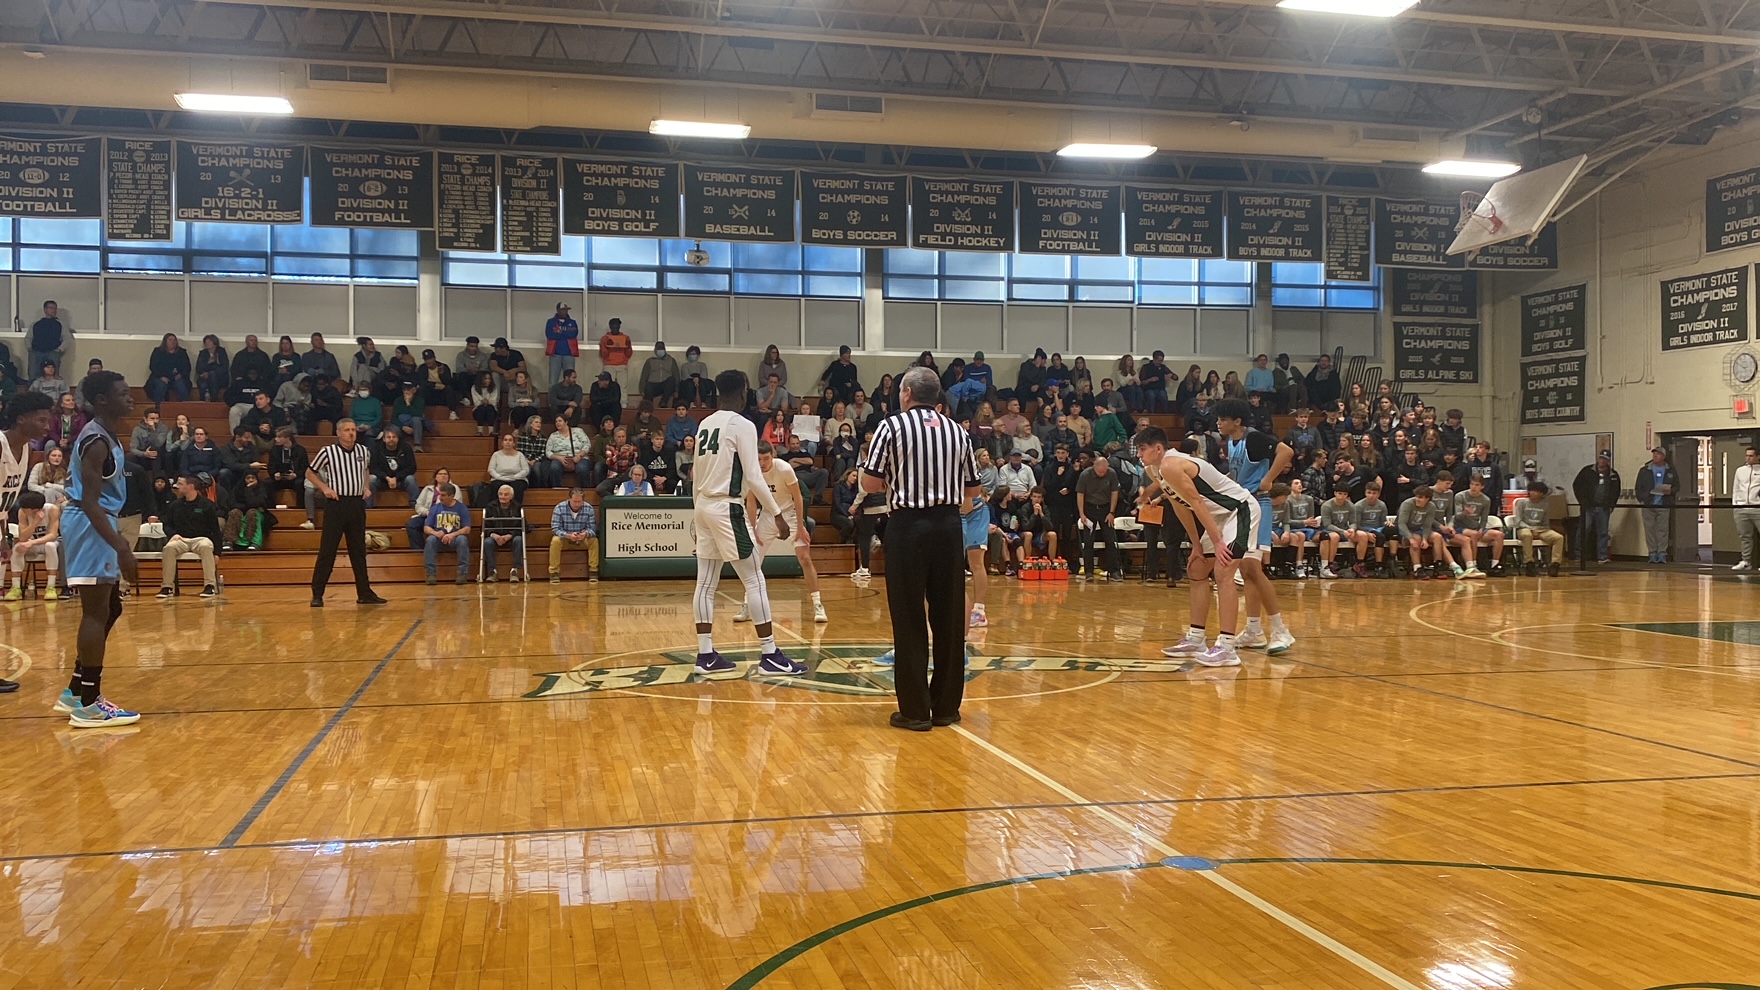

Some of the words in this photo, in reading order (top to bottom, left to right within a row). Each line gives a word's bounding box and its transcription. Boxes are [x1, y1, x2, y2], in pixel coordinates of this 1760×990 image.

[47, 143, 85, 152] STATE
[125, 142, 153, 150] RICE
[191, 145, 248, 155] VERMONT
[254, 148, 292, 158] STATE
[0, 154, 79, 166] HAMPIONS
[110, 151, 128, 160] 2012
[325, 153, 379, 164] VERMONT
[384, 156, 420, 166] STATE
[454, 155, 479, 163] RICE
[113, 162, 132, 172] STATE
[137, 163, 165, 173] CHAMPS
[198, 157, 283, 168] CHAMPIONS
[517, 158, 542, 166] RICE
[332, 167, 413, 179] CHAMPIONS
[476, 165, 492, 173] 2014
[576, 163, 627, 174] VERMONT
[632, 166, 665, 176] STATE
[59, 173, 69, 181] 12
[200, 172, 212, 180] 20
[271, 175, 281, 183] 13
[443, 175, 461, 184] STATE
[465, 176, 490, 185] CHAMPS
[584, 176, 659, 188] CHAMPIONS
[697, 172, 746, 183] VERMONT
[750, 175, 783, 185] STATE
[1716, 173, 1756, 190] VERMONT
[512, 178, 536, 188] DIVISION
[813, 179, 859, 189] VERMONT
[864, 181, 895, 190] STATE
[924, 182, 969, 191] VERMONT
[973, 184, 1003, 193] STATE
[63, 188, 73, 197] II
[218, 187, 264, 198] 16-2-1
[398, 186, 408, 194] 13
[704, 187, 776, 199] CHAMPIONS
[1032, 186, 1076, 196] VERMONT
[1080, 189, 1109, 198] STATE
[819, 194, 888, 204] CHAMPIONS
[930, 194, 996, 205] CHAMPIONS
[1137, 192, 1179, 201] VERMONT
[1184, 194, 1212, 203] STATE
[1239, 197, 1280, 205] VERMONT
[1284, 198, 1311, 207] STATE
[0, 201, 76, 212] OOTBALL
[202, 198, 262, 208] DIVISION
[268, 200, 277, 209] II
[338, 198, 394, 208] DIVISION
[399, 201, 408, 209] II
[1037, 198, 1102, 209] CHAMPIONS
[1143, 204, 1205, 214] CHAMPIONS
[1386, 203, 1425, 212] VERMONT
[1429, 206, 1456, 214] STATE
[179, 208, 221, 218] GIRLS
[226, 210, 300, 220] LACROSSE
[588, 208, 641, 219] DIVISION
[646, 210, 655, 219] II
[704, 206, 713, 214] 20
[1244, 208, 1306, 218] CHAMPIONS
[1728, 207, 1736, 215] 20
[335, 212, 411, 222] FOOTBALL
[819, 212, 828, 220] 20
[1391, 215, 1449, 225] CHAMPIONS
[584, 220, 619, 230] BOYS
[624, 222, 658, 231] GOLF
[706, 224, 774, 235] BASEBALL
[934, 224, 981, 233] DIVISION
[984, 226, 992, 234] II
[812, 229, 843, 239] BOYS
[847, 231, 896, 240] SOCCER
[1041, 229, 1086, 239] DIVISION
[1090, 231, 1098, 239] II
[1146, 232, 1190, 241] DIVISION
[1194, 234, 1202, 242] II
[1721, 232, 1748, 245] BOYS
[920, 235, 954, 244] FIELD
[958, 237, 1005, 246] HOCKEY
[1039, 240, 1100, 251] FOOTBALL
[1248, 236, 1292, 245] DIVISION
[1134, 244, 1155, 252] GIRLS
[1159, 244, 1184, 252] INDOOR
[1189, 245, 1212, 254] TRACK
[1239, 247, 1257, 255] BOYS
[1261, 248, 1284, 256] INDOOR
[1289, 249, 1312, 257] TRACK
[1396, 242, 1436, 252] DIVISION
[1489, 246, 1529, 254] DIVISION
[1392, 254, 1447, 264] BASEBALL
[1477, 256, 1503, 264] BOYS
[1507, 257, 1548, 265] SOCCER
[1408, 273, 1462, 281] CHAMPIONS
[1668, 278, 1707, 293] VERMONT
[1711, 272, 1738, 286] STATE
[1528, 294, 1556, 306] VERMONT
[1558, 290, 1578, 300] STATE
[1671, 286, 1737, 307] CHAMPIONS
[1448, 306, 1468, 314] TRACK
[1532, 302, 1574, 316] CHAMPIONS
[1670, 311, 1685, 320] 2016
[1722, 303, 1737, 312] 2017
[1402, 326, 1442, 335] VERMONT
[1446, 328, 1471, 336] STATE
[1679, 319, 1717, 333] DIVISION
[1720, 318, 1728, 327] II
[1534, 328, 1562, 340] DIVISION
[1670, 336, 1687, 346] GIRLS
[1690, 333, 1713, 343] INDOOR
[1716, 329, 1738, 340] TRACK
[1403, 339, 1469, 349] CHAMPIONS
[1532, 342, 1549, 352] BOYS
[1553, 339, 1573, 349] GOLF
[1527, 365, 1556, 376] VERMONT
[1559, 362, 1579, 372] STATE
[1400, 370, 1424, 378] GIRLS
[1427, 370, 1456, 379] ALPINE
[1460, 371, 1473, 380] SKI
[1528, 376, 1578, 390] CHAMPIONS
[1539, 408, 1554, 417] CROSS
[1557, 406, 1580, 416] COUNTRY
[699, 428, 720, 456] 24
[437, 514, 460, 528] RAMS
[612, 522, 632, 530] Rice
[635, 521, 684, 530] Memorial
[151, 526, 160, 534] R
[618, 543, 641, 554] High
[644, 543, 677, 552] School
